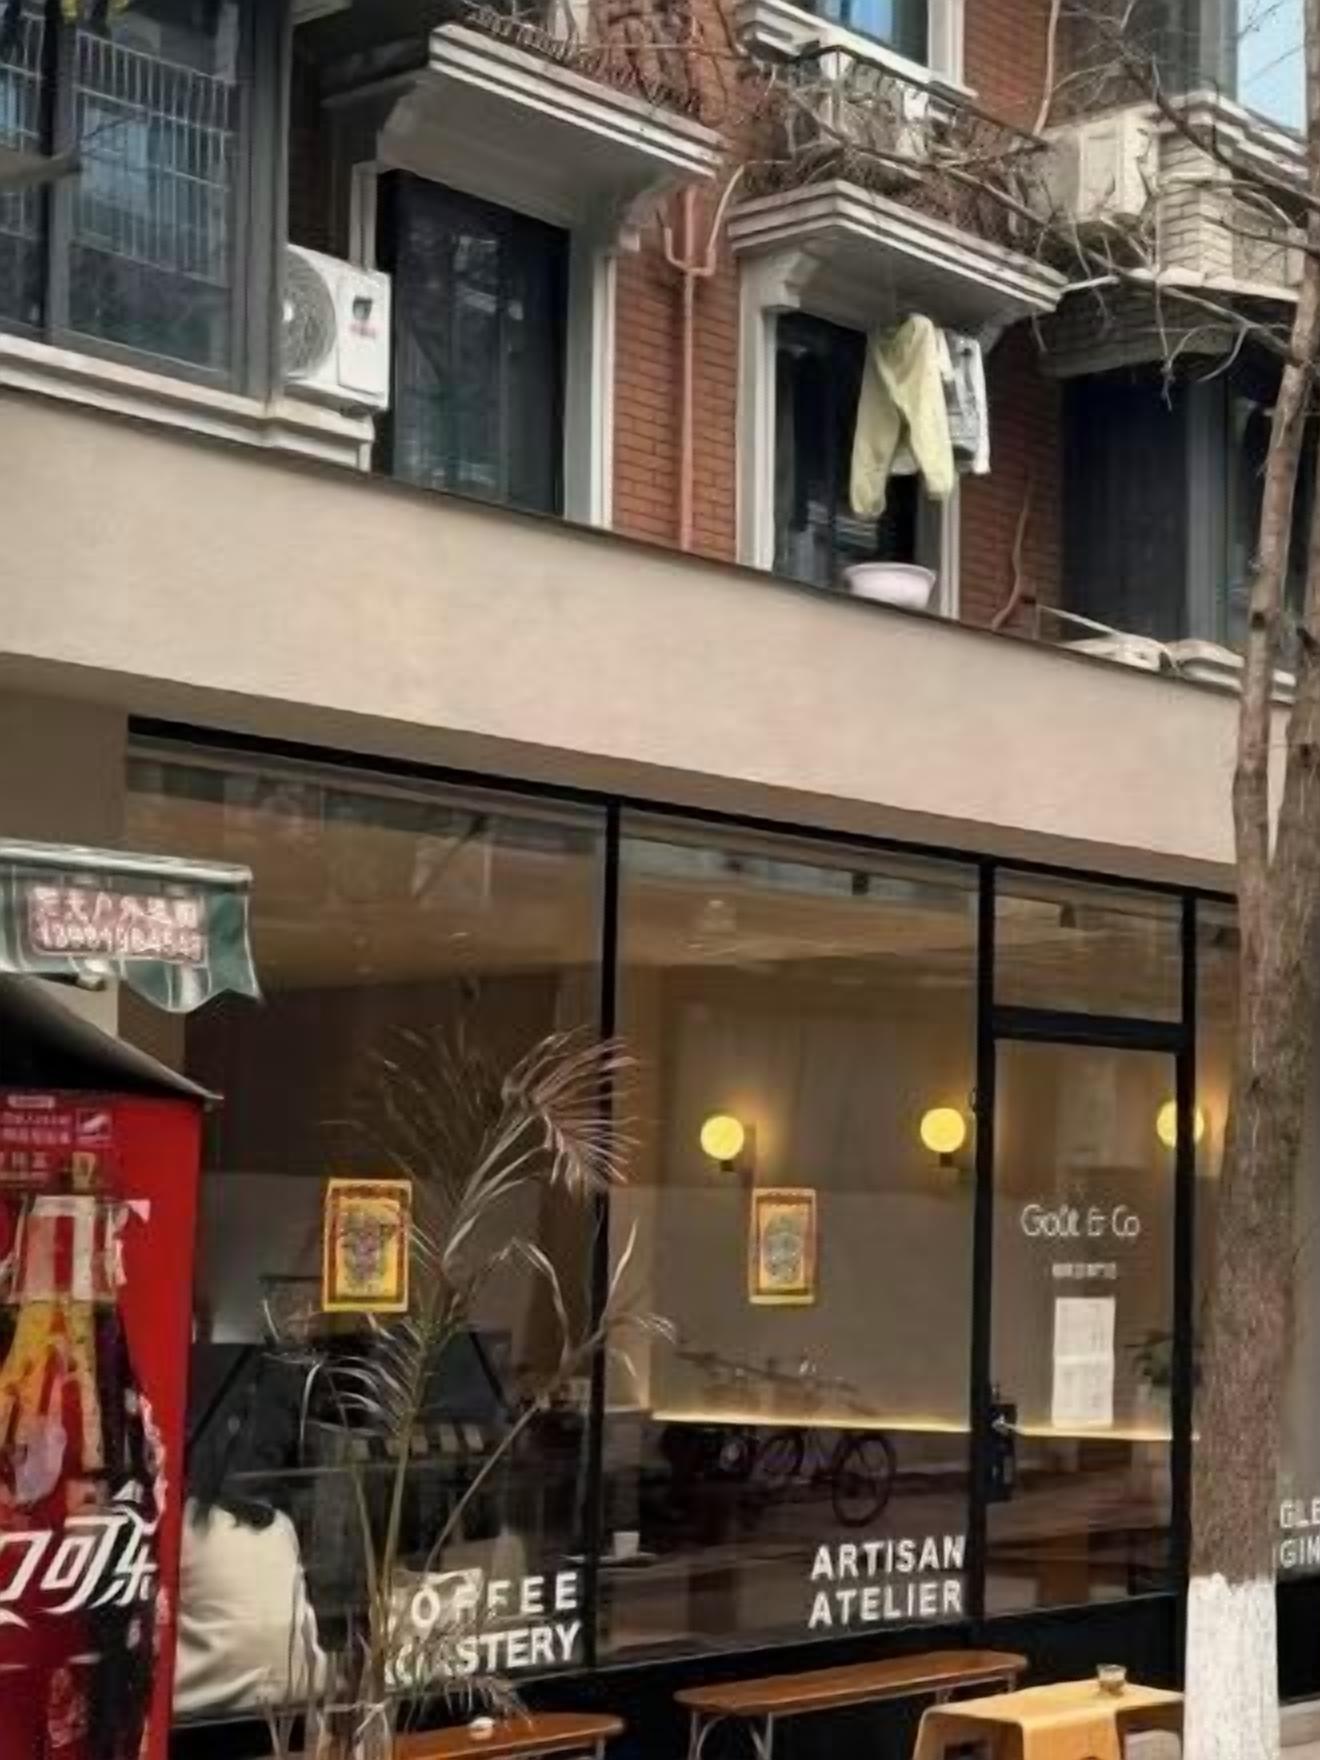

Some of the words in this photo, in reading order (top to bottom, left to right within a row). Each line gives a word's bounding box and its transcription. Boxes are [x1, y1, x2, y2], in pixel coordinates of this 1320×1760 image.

[809, 1534, 967, 1581] ARTISAN
[390, 1571, 578, 1632] OFFEE
[807, 1579, 963, 1629] ATELIER
